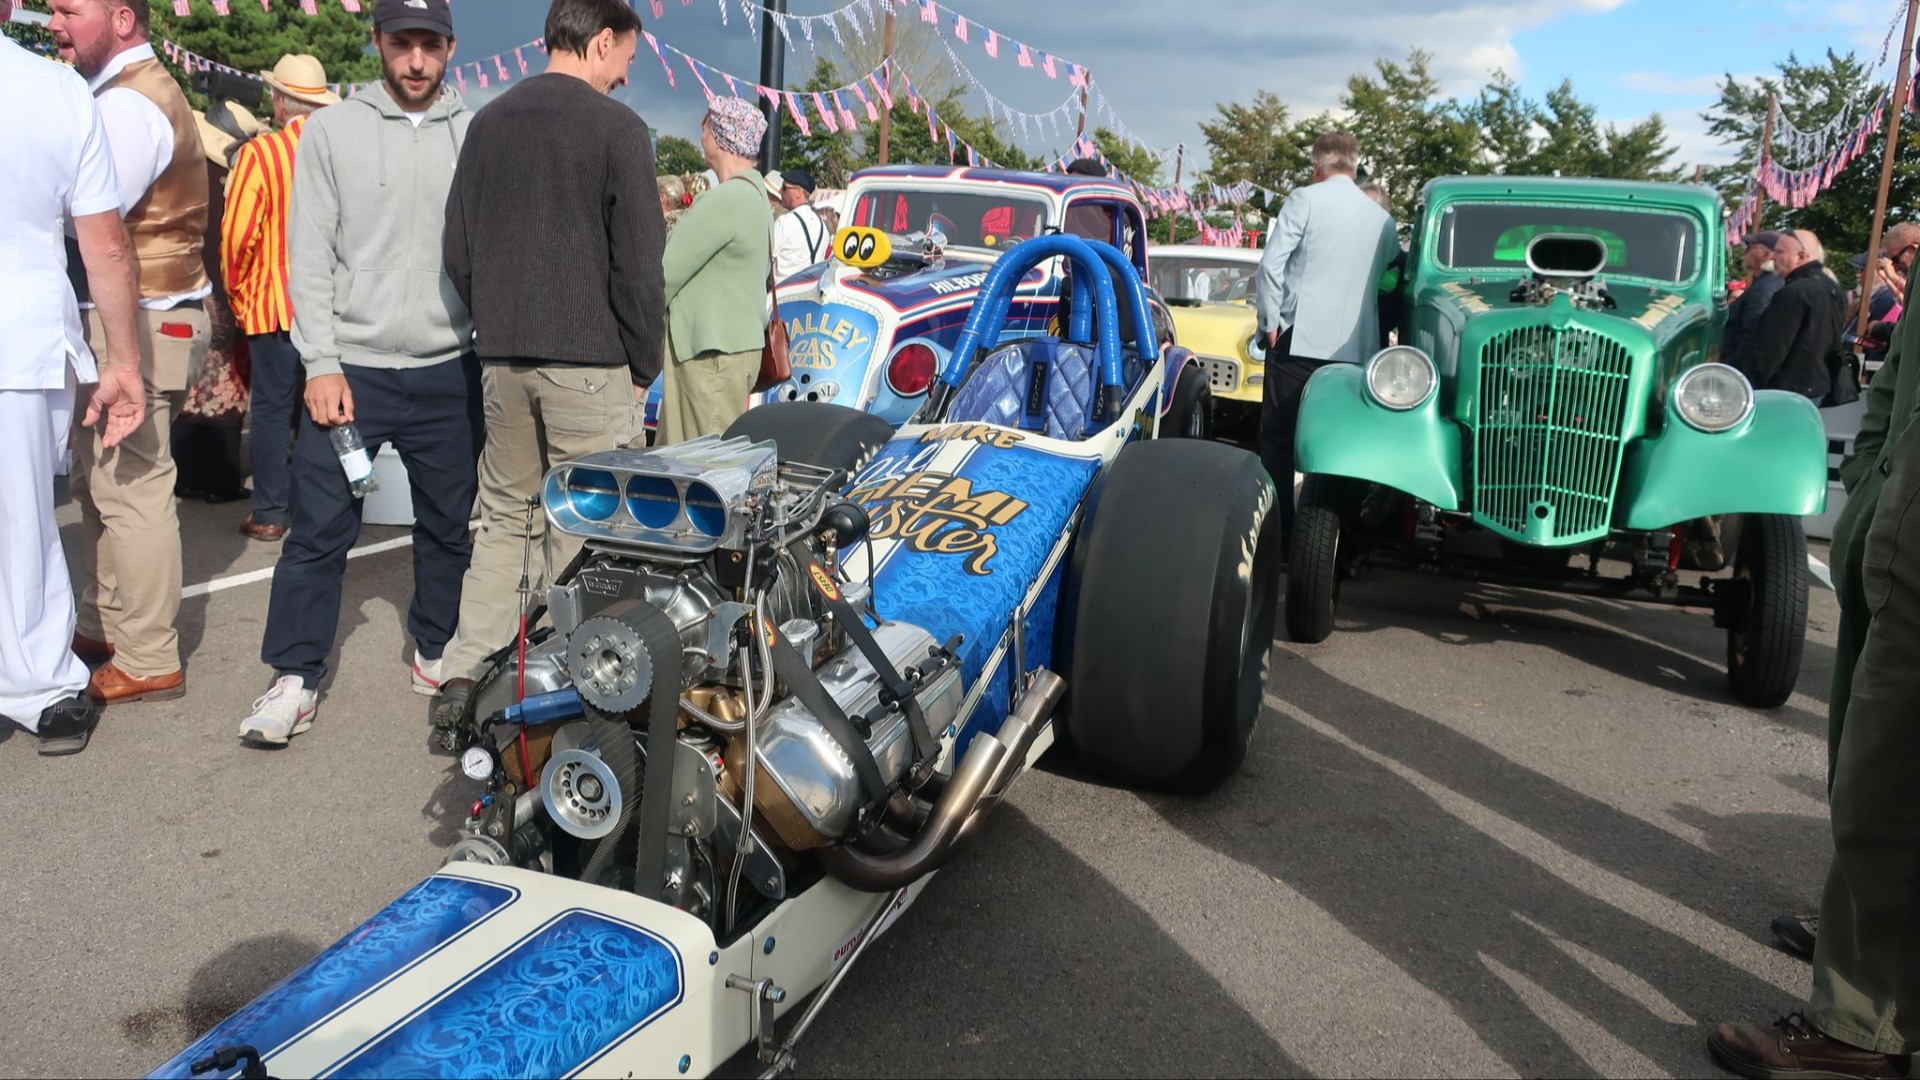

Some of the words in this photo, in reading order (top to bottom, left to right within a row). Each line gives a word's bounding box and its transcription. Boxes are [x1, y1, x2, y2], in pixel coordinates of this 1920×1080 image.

[917, 424, 1026, 449] MIKE
[846, 471, 1030, 527] HEMI
[812, 569, 834, 592] DEIST
